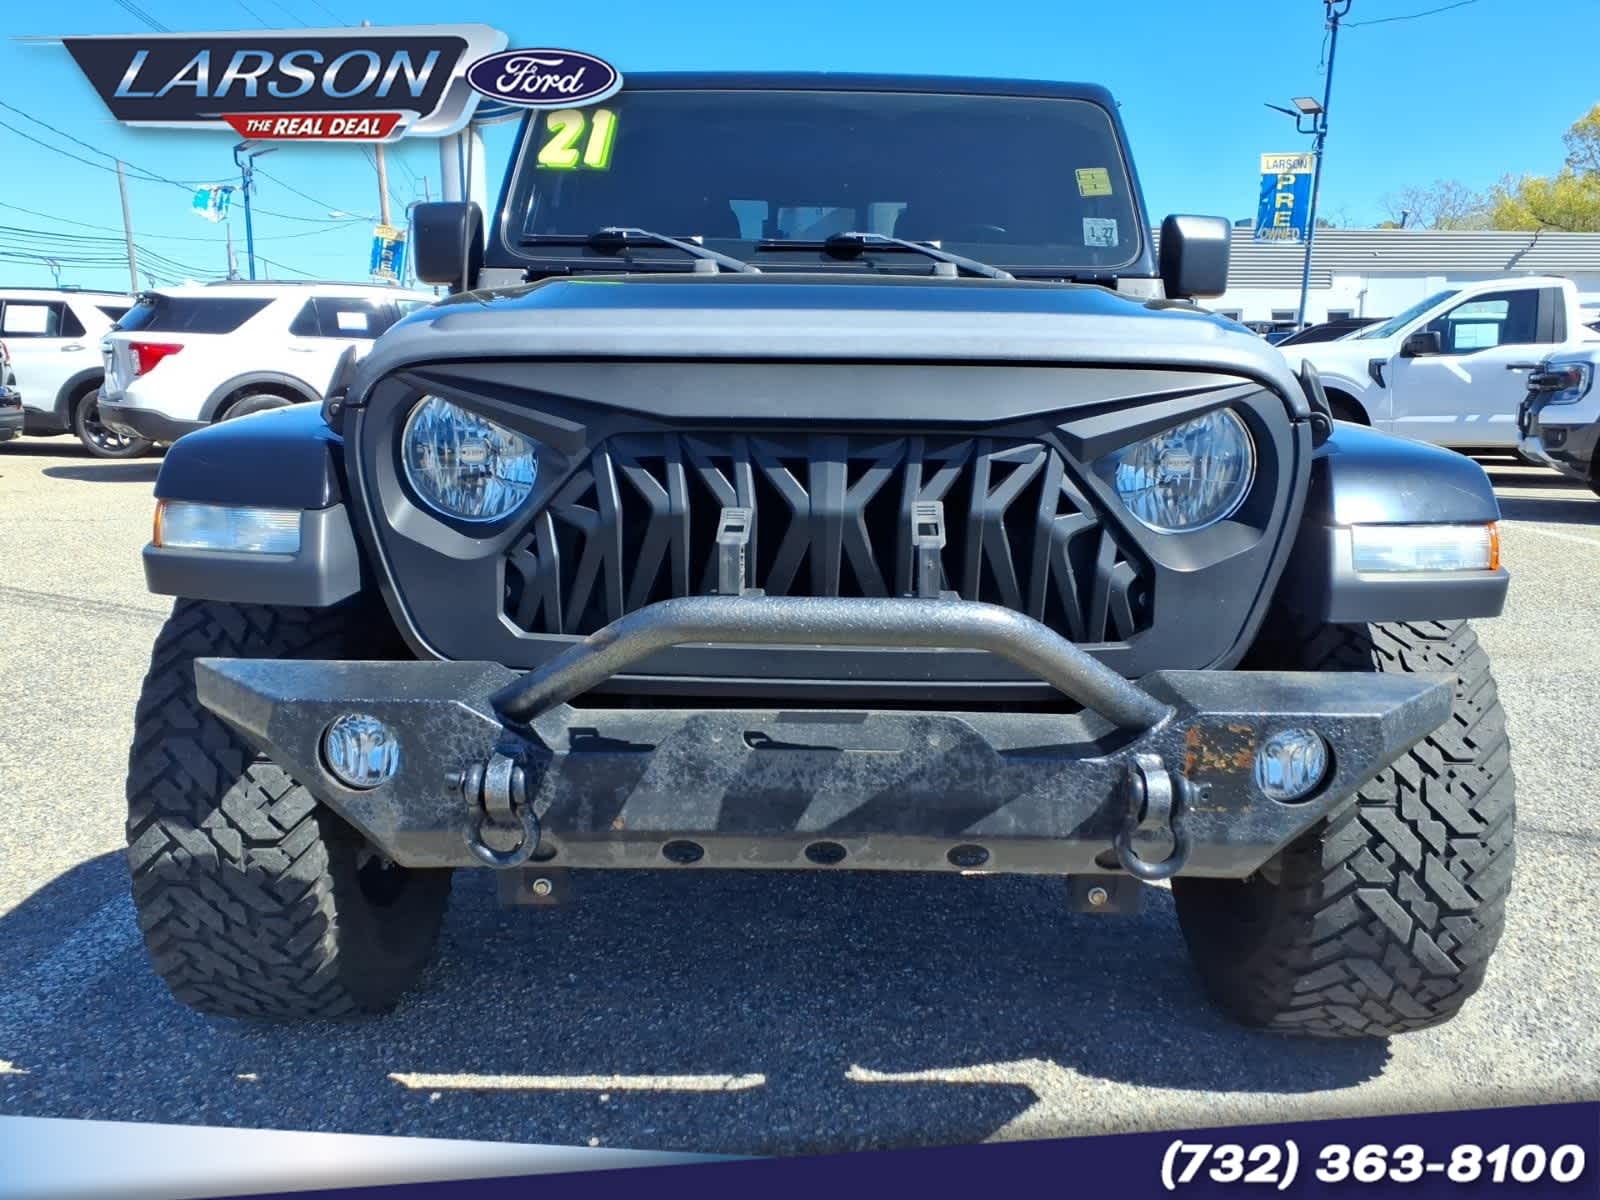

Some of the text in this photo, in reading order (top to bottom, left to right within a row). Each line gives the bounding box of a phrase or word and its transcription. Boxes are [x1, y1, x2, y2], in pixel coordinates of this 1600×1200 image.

[538, 108, 616, 168] 21
[1265, 158, 1308, 169] LARSON
[1273, 174, 1296, 227] PRE
[1260, 227, 1300, 241] OWNED
